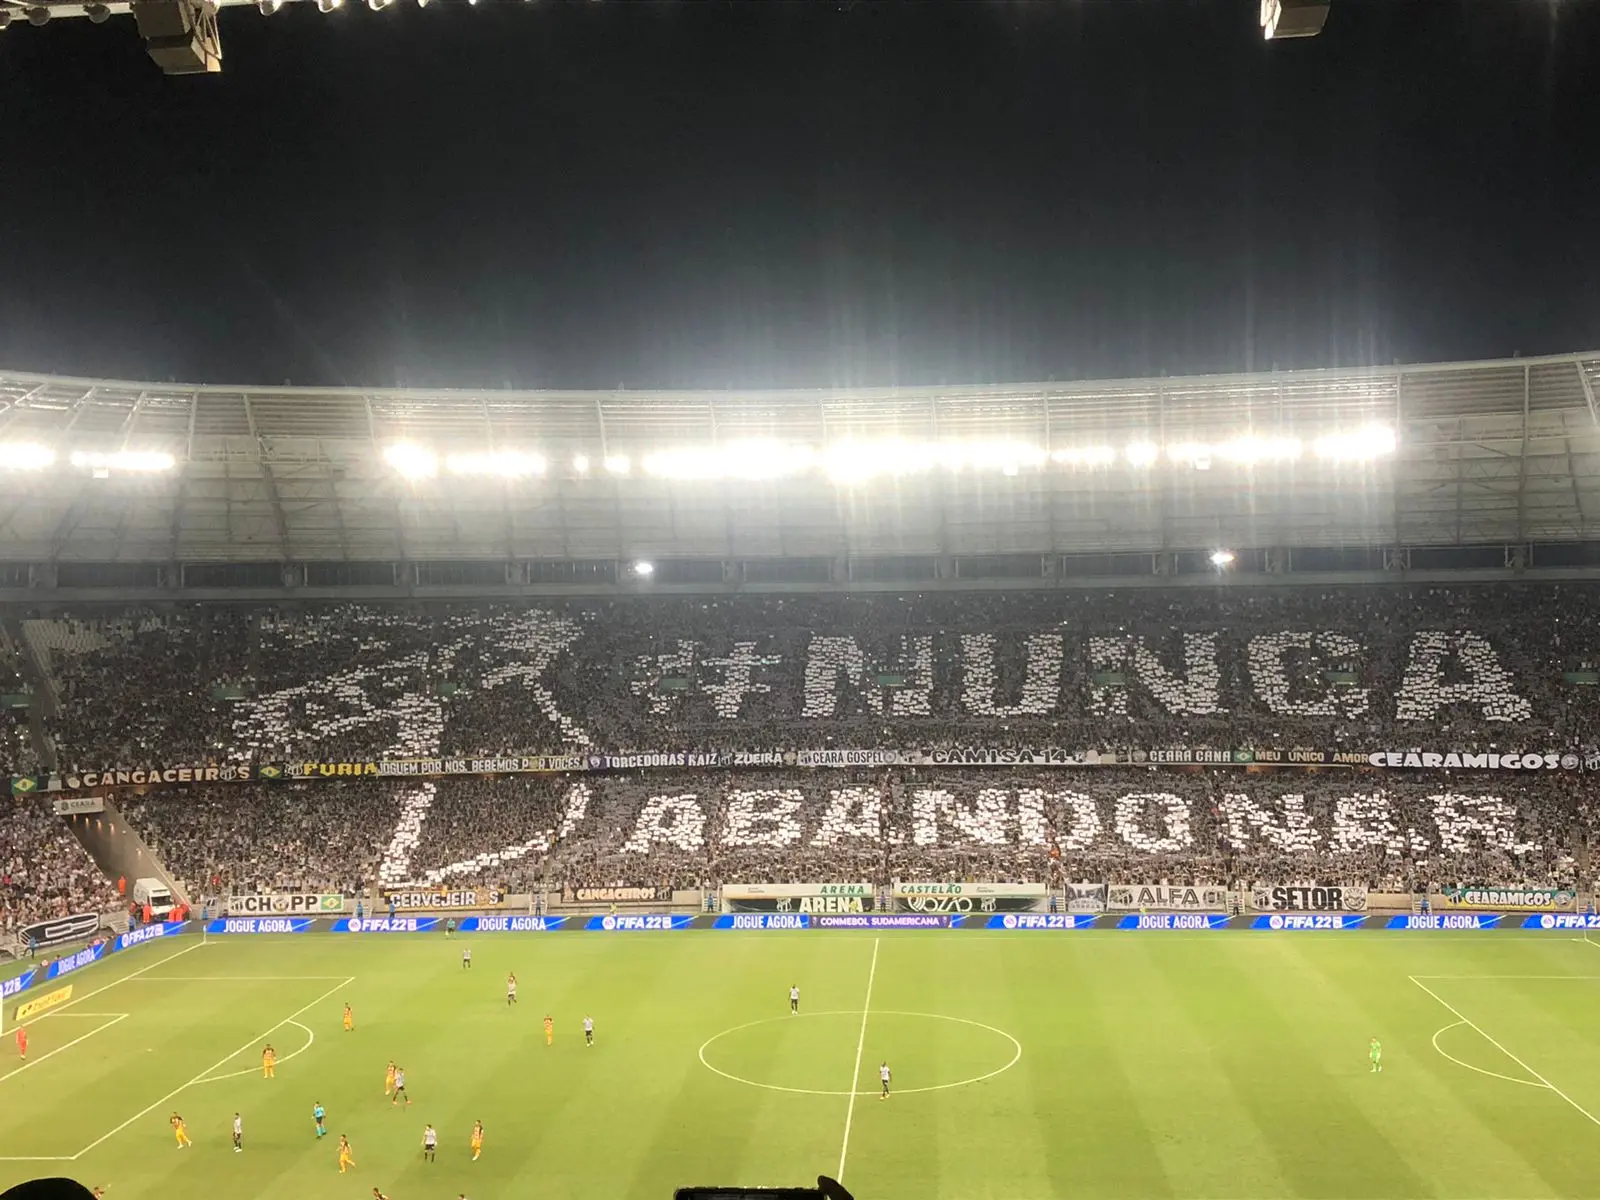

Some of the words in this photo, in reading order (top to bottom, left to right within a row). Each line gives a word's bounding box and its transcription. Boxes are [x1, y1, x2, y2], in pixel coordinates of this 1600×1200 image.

[604, 753, 685, 768] TORCEDORAS
[734, 753, 782, 764] ZUEIRA
[847, 751, 883, 763] GOSPEL
[930, 749, 1035, 764] CAMISA
[1039, 749, 1068, 764] 14
[1255, 751, 1281, 762] MEU
[1332, 752, 1369, 763] AMOR
[1368, 752, 1560, 771] CEARAMIGOS
[304, 763, 377, 776] FURIA
[378, 761, 418, 776] JOGUEM
[421, 761, 442, 774] POR
[471, 758, 519, 772] BEBEMOS
[84, 767, 250, 787] CANGACEIRS
[820, 885, 865, 894] ARENA
[901, 884, 962, 894] CASTELÃO
[1138, 887, 1200, 904] ALFA
[245, 895, 318, 912] CHPP
[391, 891, 500, 908] CERVEJEIRS
[799, 896, 864, 913] ARENA
[1272, 887, 1343, 911] SETOR
[1464, 890, 1552, 906] CEARAMIGOS
[223, 919, 256, 932] JOGUE
[258, 919, 293, 932] AGORA
[362, 918, 390, 931] FIFA
[391, 918, 407, 931] 22
[476, 918, 508, 931] JOGUE
[511, 917, 546, 930] AGORA
[616, 916, 645, 929] FIFA
[645, 916, 661, 929] 22
[731, 916, 763, 929] JOGUE
[766, 915, 802, 928] AGORA
[820, 916, 869, 927] CONMEBOL
[871, 917, 939, 926] SUDAMERICANA
[1018, 916, 1047, 928] FIFA
[1047, 916, 1064, 928] 22
[1137, 915, 1170, 928] JOGUE
[1173, 915, 1210, 928] AGORA
[1284, 915, 1313, 928] FIFA
[1313, 915, 1331, 928] 22
[1405, 916, 1440, 928] JOGUE
[1443, 915, 1480, 928] AGORA
[1556, 916, 1586, 928] FIFA
